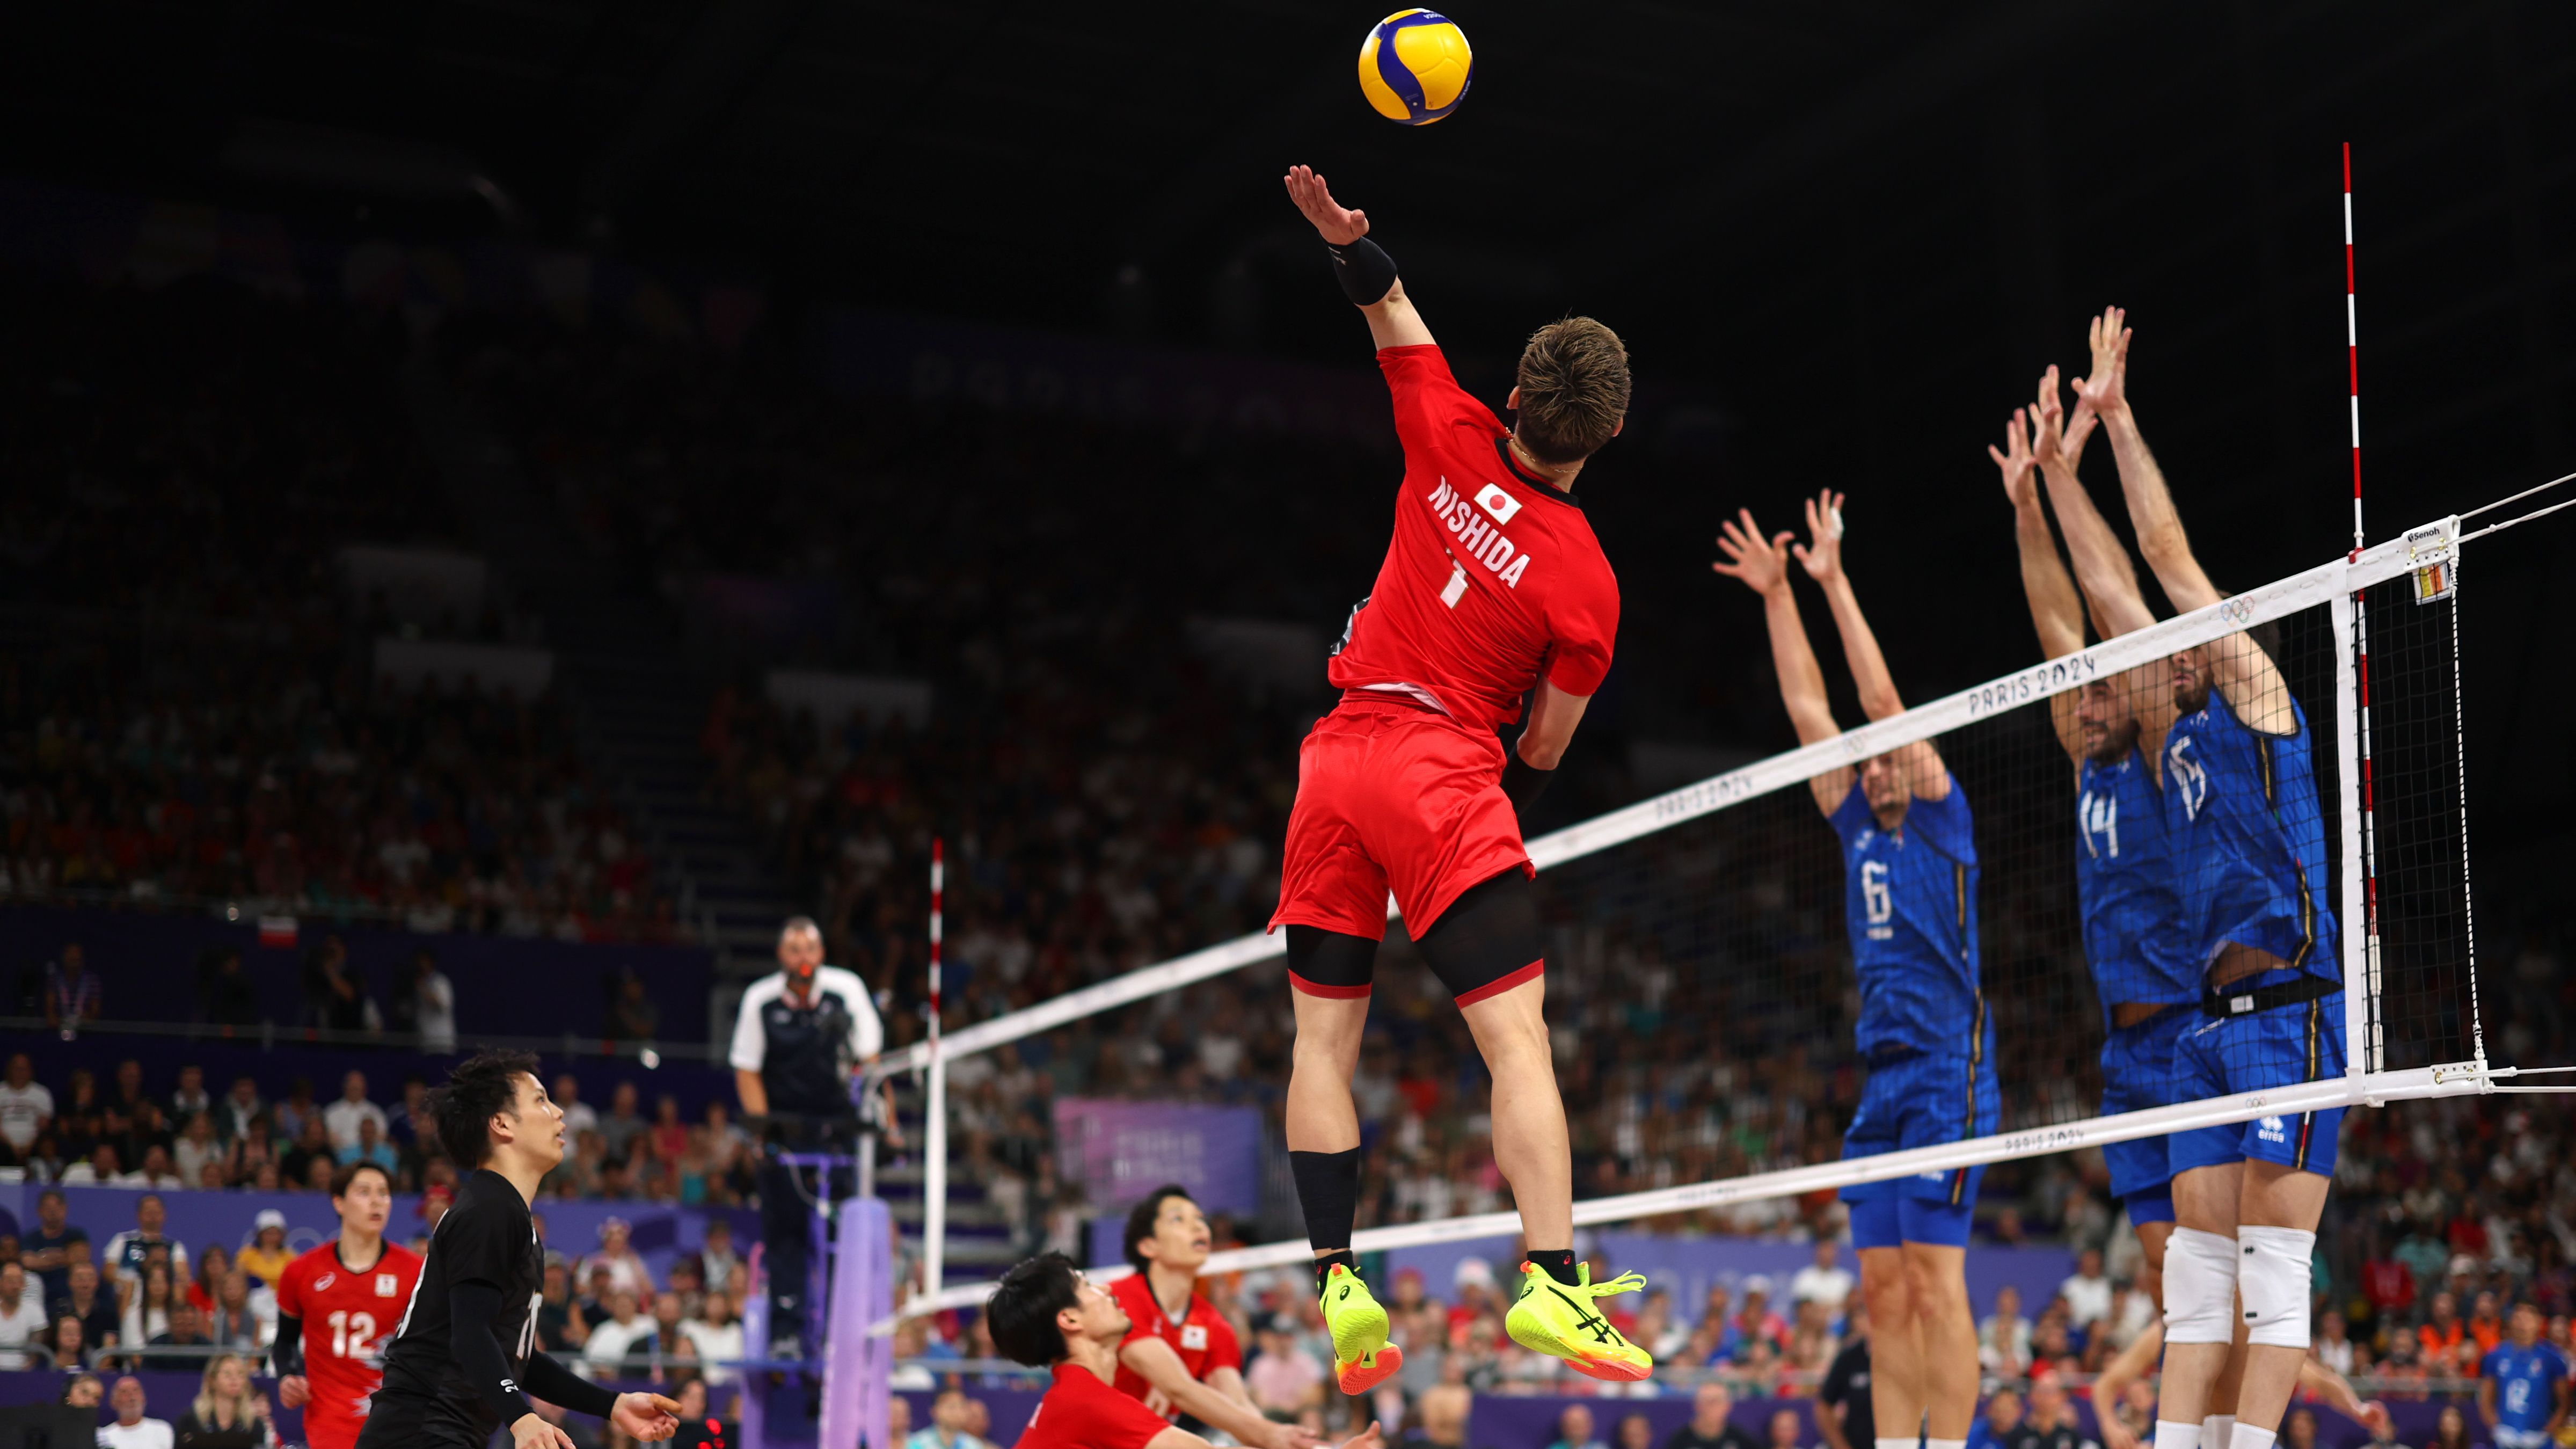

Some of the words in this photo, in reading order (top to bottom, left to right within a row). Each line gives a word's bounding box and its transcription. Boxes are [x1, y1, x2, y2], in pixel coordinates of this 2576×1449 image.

[1427, 475, 1530, 589] NISHIDA
[2414, 527, 2440, 541] Senoh
[1440, 547, 1469, 609] 1
[1969, 675, 2029, 716] PARIS
[2038, 653, 2095, 693] 2024
[2079, 790, 2119, 858] 14
[1862, 860, 1892, 924] 6
[2048, 1128, 2084, 1148] 2024
[327, 1309, 376, 1359] 12
[500, 1379, 519, 1393] 20
